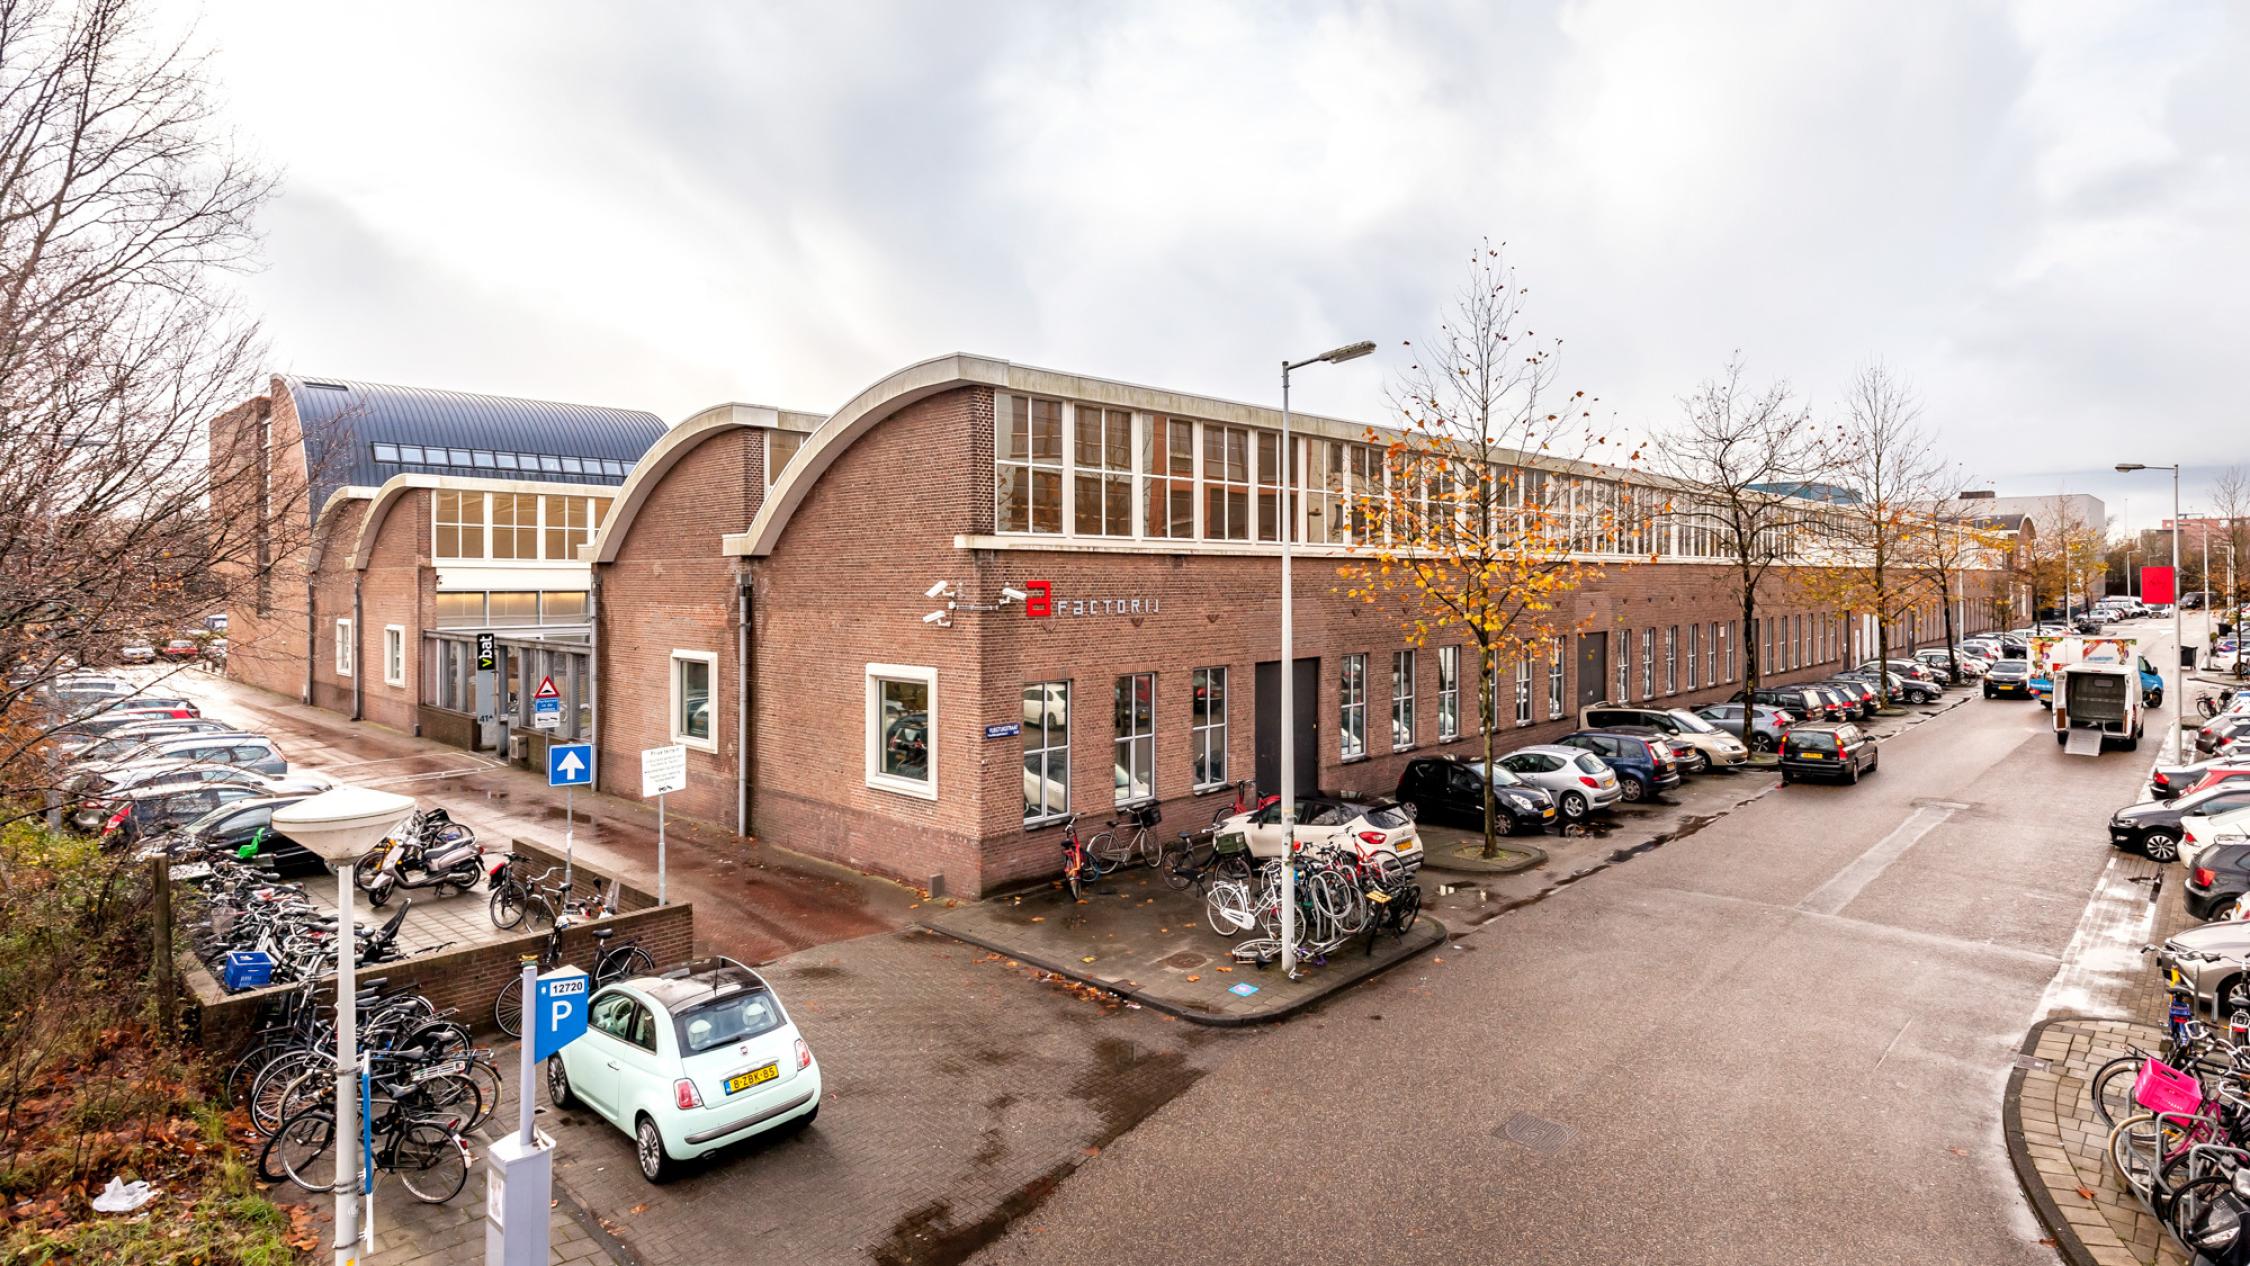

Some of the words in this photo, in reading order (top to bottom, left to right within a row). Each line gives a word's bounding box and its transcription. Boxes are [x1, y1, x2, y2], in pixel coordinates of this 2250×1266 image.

[479, 635, 493, 667] vbat
[553, 982, 583, 994] 12720
[551, 1000, 573, 1032] P
